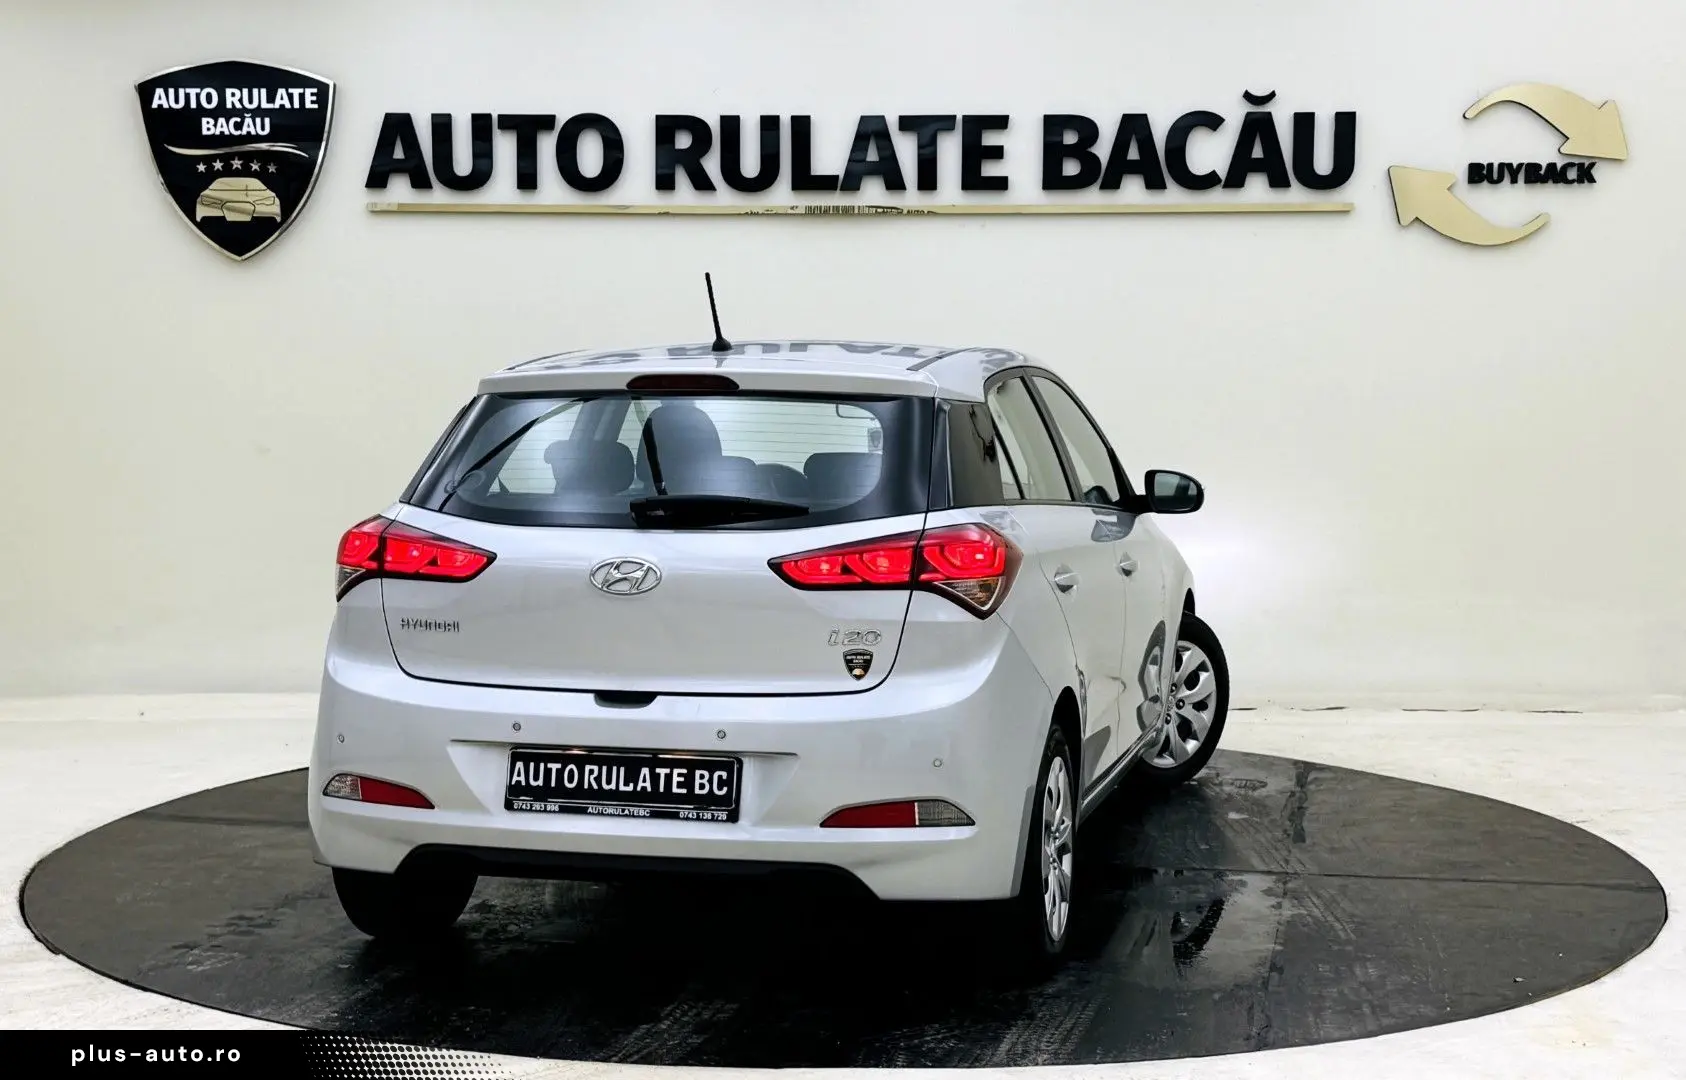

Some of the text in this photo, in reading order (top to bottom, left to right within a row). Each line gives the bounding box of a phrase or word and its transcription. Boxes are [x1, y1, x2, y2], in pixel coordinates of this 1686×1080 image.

[151, 87, 318, 109] AUTO RULATE
[201, 113, 271, 136] BACĂU
[365, 89, 1357, 193] AUTO RULATE BACĂU
[1467, 161, 1597, 185] BUYBACK
[511, 761, 728, 796] AUTO RULATE BC
[587, 806, 650, 817] AUTORULATEBC
